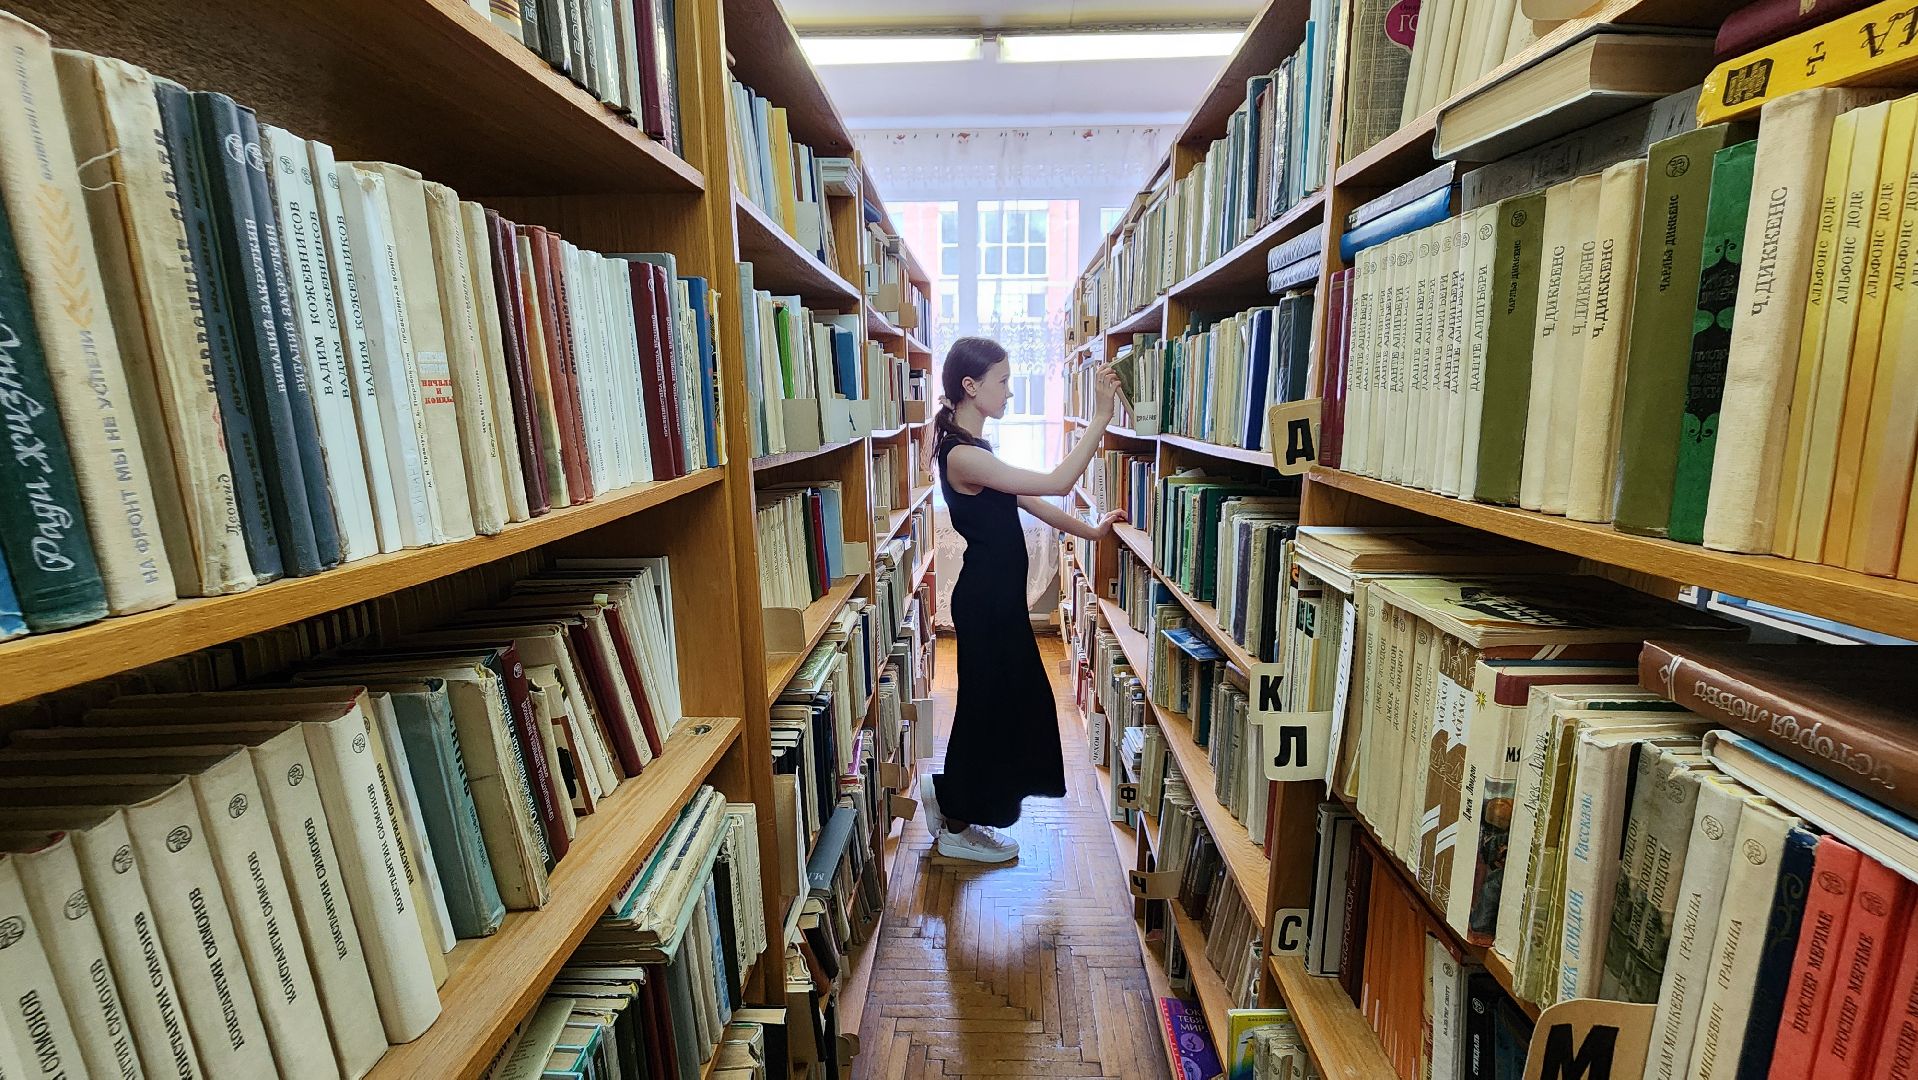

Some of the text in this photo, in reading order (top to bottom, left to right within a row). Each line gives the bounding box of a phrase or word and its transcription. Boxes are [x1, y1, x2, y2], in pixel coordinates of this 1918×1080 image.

[1660, 194, 1679, 294] ЧАРЛЬЗ ДИККЕНС
[1751, 186, 1788, 317] Ч.ДИККЕНС
[1811, 196, 1837, 306] АЛЬФОНС ДОДЕ
[1835, 190, 1864, 305] АЛЬФОНС ДОДЕ
[1865, 182, 1894, 299] АЛЬФОНС ДОДЕ
[1893, 171, 1918, 292] АЛЬФОНС ДОДЕ
[244, 218, 287, 392] ВИТАЛИЙ ЗАКРУТКИН
[264, 223, 308, 391] ВИТАЛИЙ ЗАКРУТКИН
[289, 200, 334, 396] ВАДИМ КОЖЕВНИКОВ
[309, 210, 350, 398] ВАДИМ КОЖЕВНИКОВ
[336, 214, 375, 398] ВАДИМ КОЖЕВНИКОВ
[1443, 270, 1460, 389] ДАНТЕ АЛИГЬЕРИ
[1470, 264, 1488, 391] ДАНТЕ АЛИГЬЕРИ
[1593, 239, 1614, 338] Ч.ДИККЕНС
[1380, 352, 1388, 389] ДАНТЕ
[1390, 287, 1404, 391] ДАНТЕ АЛИГЬЕРИ
[1412, 279, 1426, 389] ДАНТЕ АЛИГЬЕРИ
[79, 330, 160, 585] НА ФРОНТ МЫ НЕ УСПЕЛИ
[1287, 418, 1315, 465] Д
[26, 479, 76, 572] Ради
[218, 473, 240, 536] Леонид
[1066, 542, 1073, 551] С
[497, 674, 513, 727] письмах
[1259, 675, 1284, 712] К
[1375, 637, 1387, 715] ДЖЕК ЛОНДОН
[1387, 645, 1397, 723] ДЖЕК ЛОНДОН
[1395, 649, 1403, 693] ЛОНДОН
[1411, 662, 1423, 743] ДЖЕК ЛОНДОН
[511, 735, 540, 820] Отечественная
[1274, 726, 1307, 767] Л
[377, 763, 414, 884] КОНСТАНТИН СИМОНОВ
[1120, 786, 1136, 803] Ф
[1463, 764, 1477, 823] Джек Лондон
[1575, 792, 1592, 862] Рассказы
[368, 784, 407, 914] КОНСТАНТИН СИМОНОВ
[531, 820, 551, 864] Великая
[1624, 817, 1639, 873] ЛОНДОН
[1639, 834, 1658, 892] ЛОНДОН
[1651, 845, 1672, 908] ЛОНДОН
[248, 851, 297, 1004] КОНСТАНТИН СИМОНОВ
[304, 818, 347, 960] КОНСТАНТИН СИМОНОВ
[134, 912, 165, 990] СИМОНОВ
[189, 888, 244, 1051] КОНСТАНТИН СИМОНОВ
[1278, 915, 1302, 950] С
[1664, 974, 1687, 1047] МИЦКЕВИЧ
[1680, 892, 1701, 961] ГРАЖИНА
[1719, 919, 1743, 990] ГРАЖИНА
[1793, 912, 1834, 1035] ПРОСПЕР МЕРИМЕ
[90, 959, 121, 1037] СИМОНОВ
[1560, 963, 1579, 1001] ЖЕК
[1832, 933, 1874, 1061] ПРОСПЕР МЕРИМЕ
[19, 989, 60, 1073] СИМОНОВ
[1472, 1033, 1480, 1075] СТЕНДАЛЬ
[1540, 1024, 1620, 1080] М
